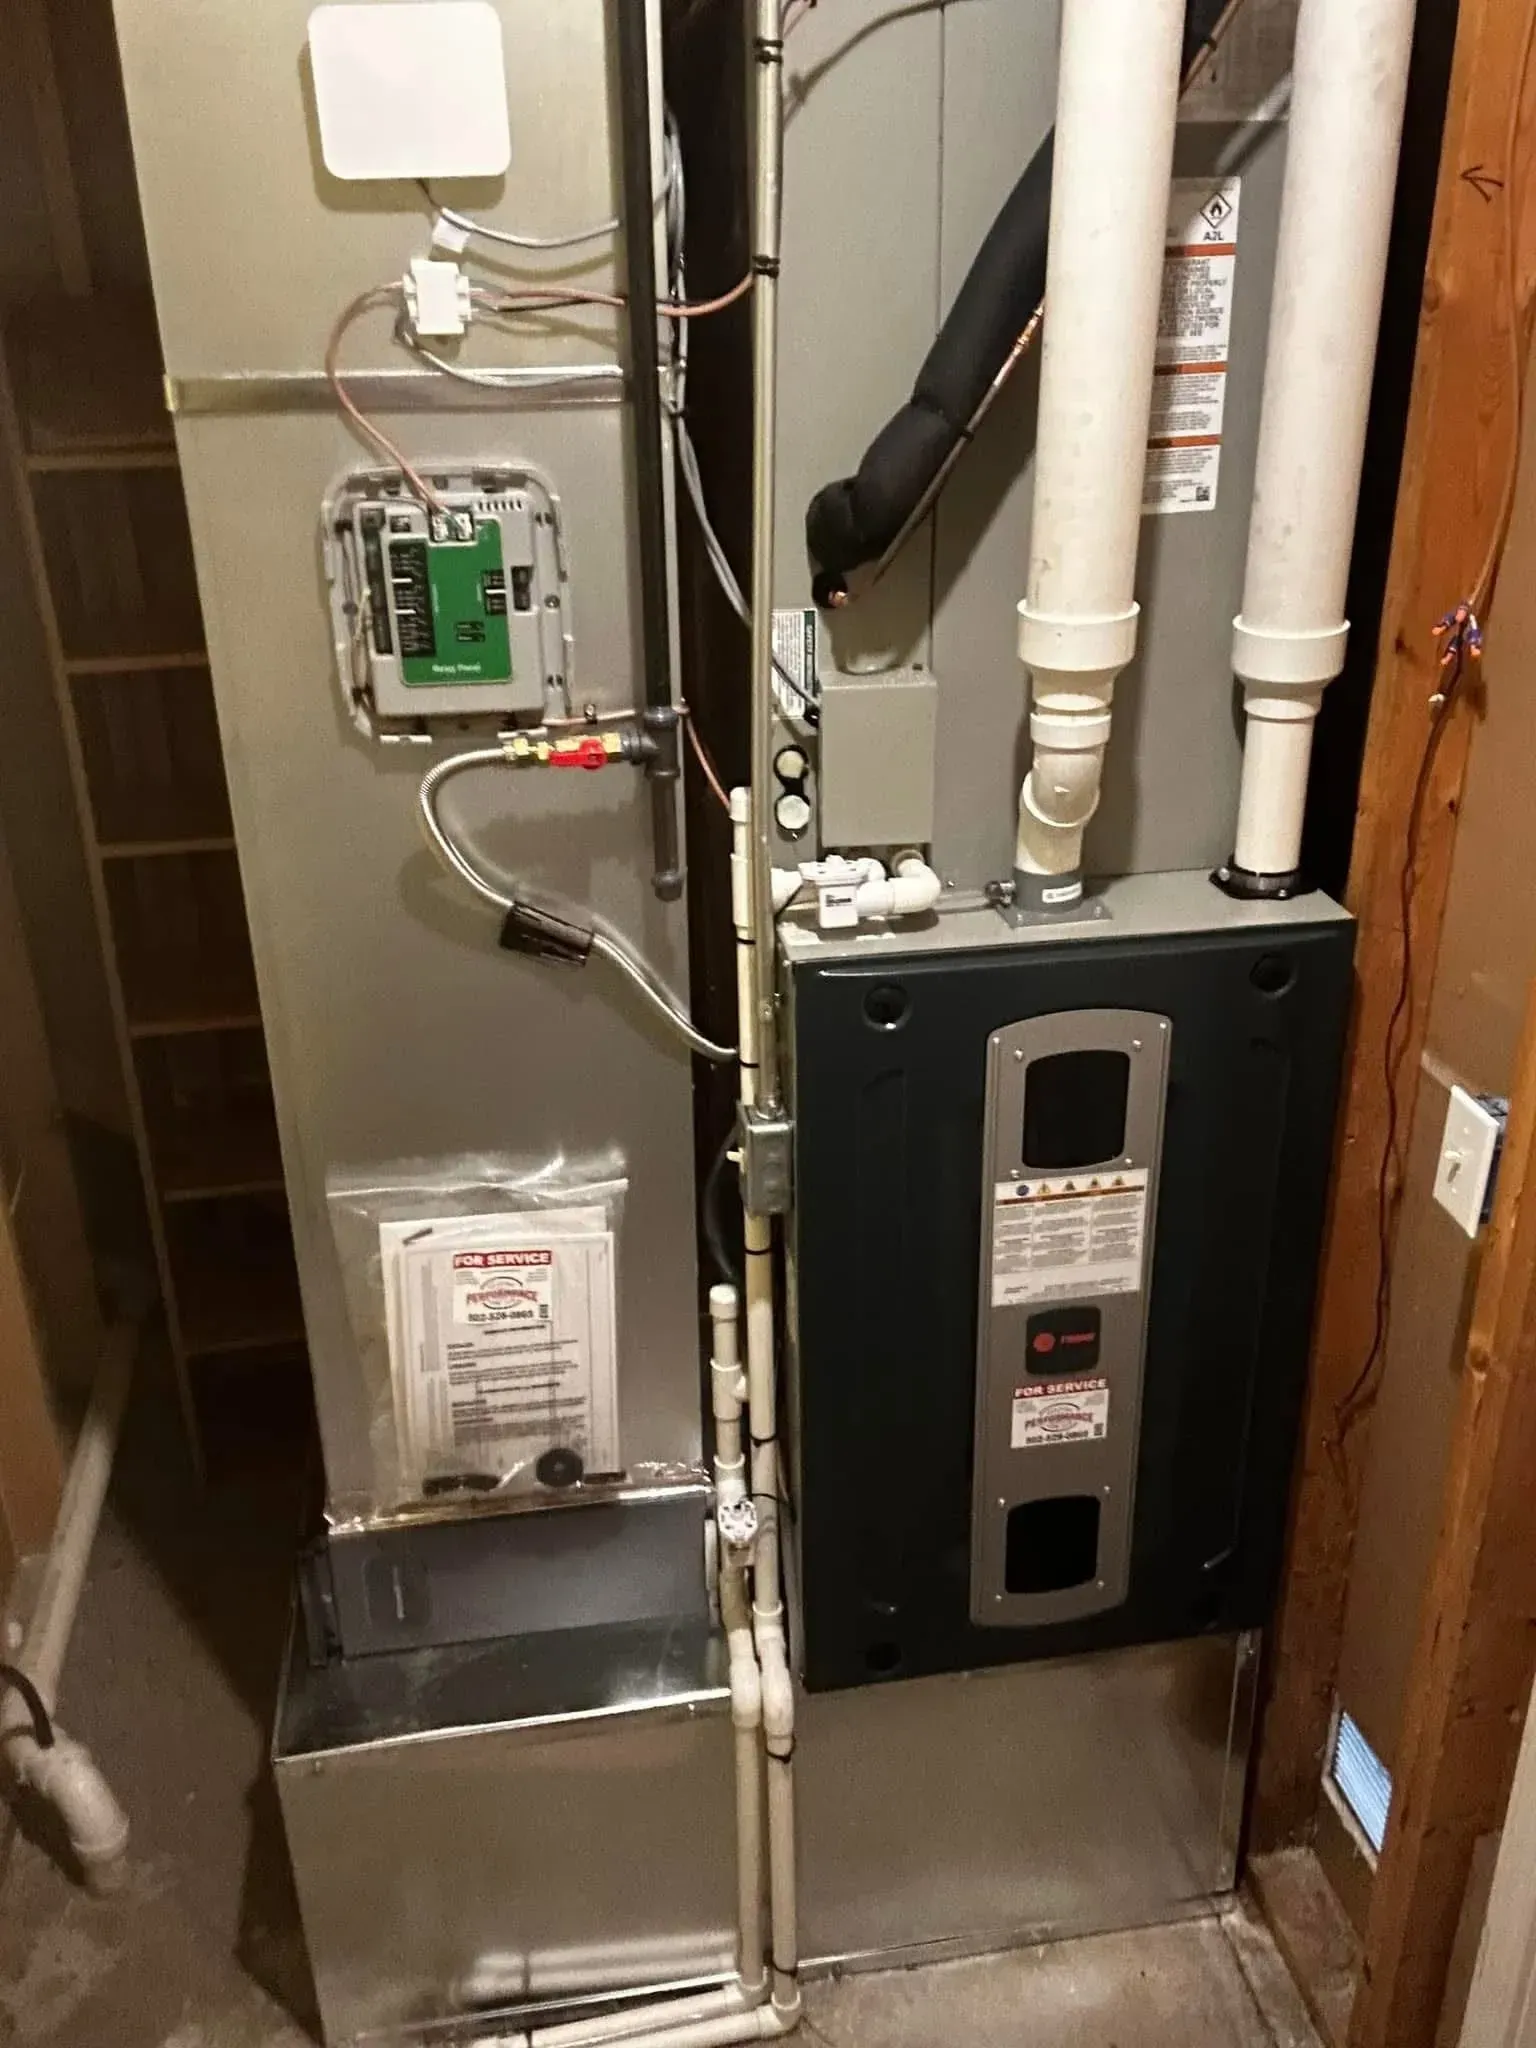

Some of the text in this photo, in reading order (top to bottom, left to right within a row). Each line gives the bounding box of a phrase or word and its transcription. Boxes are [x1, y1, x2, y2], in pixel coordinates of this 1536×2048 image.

[1203, 231, 1224, 241] A2L
[455, 1252, 550, 1267] FOR SERVICE
[1015, 1378, 1107, 1398] FOR SERVICE
